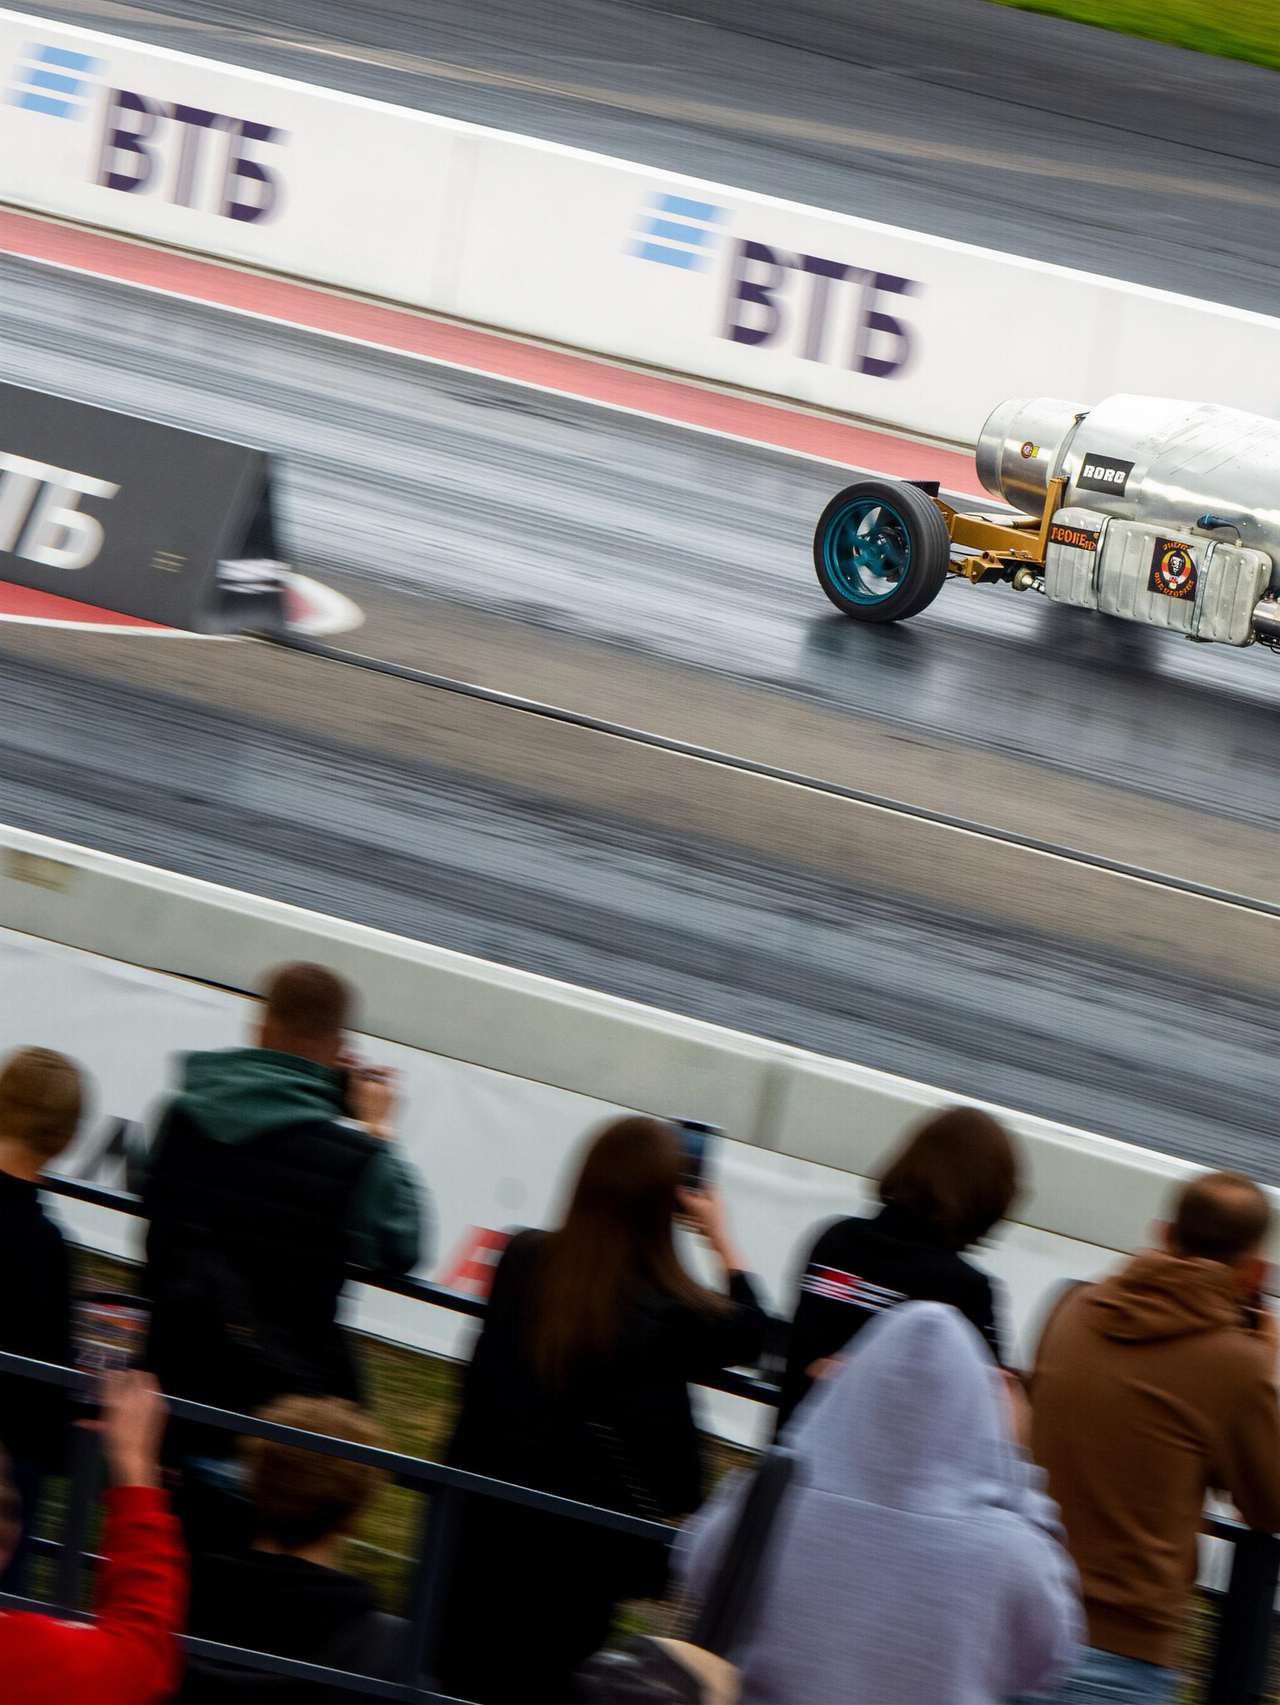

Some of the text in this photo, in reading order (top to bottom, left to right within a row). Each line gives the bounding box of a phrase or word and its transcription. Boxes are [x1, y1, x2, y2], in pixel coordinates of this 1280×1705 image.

[90, 84, 291, 225] ВТБ
[714, 236, 928, 380] ВТБ
[0, 450, 121, 570] ТБ
